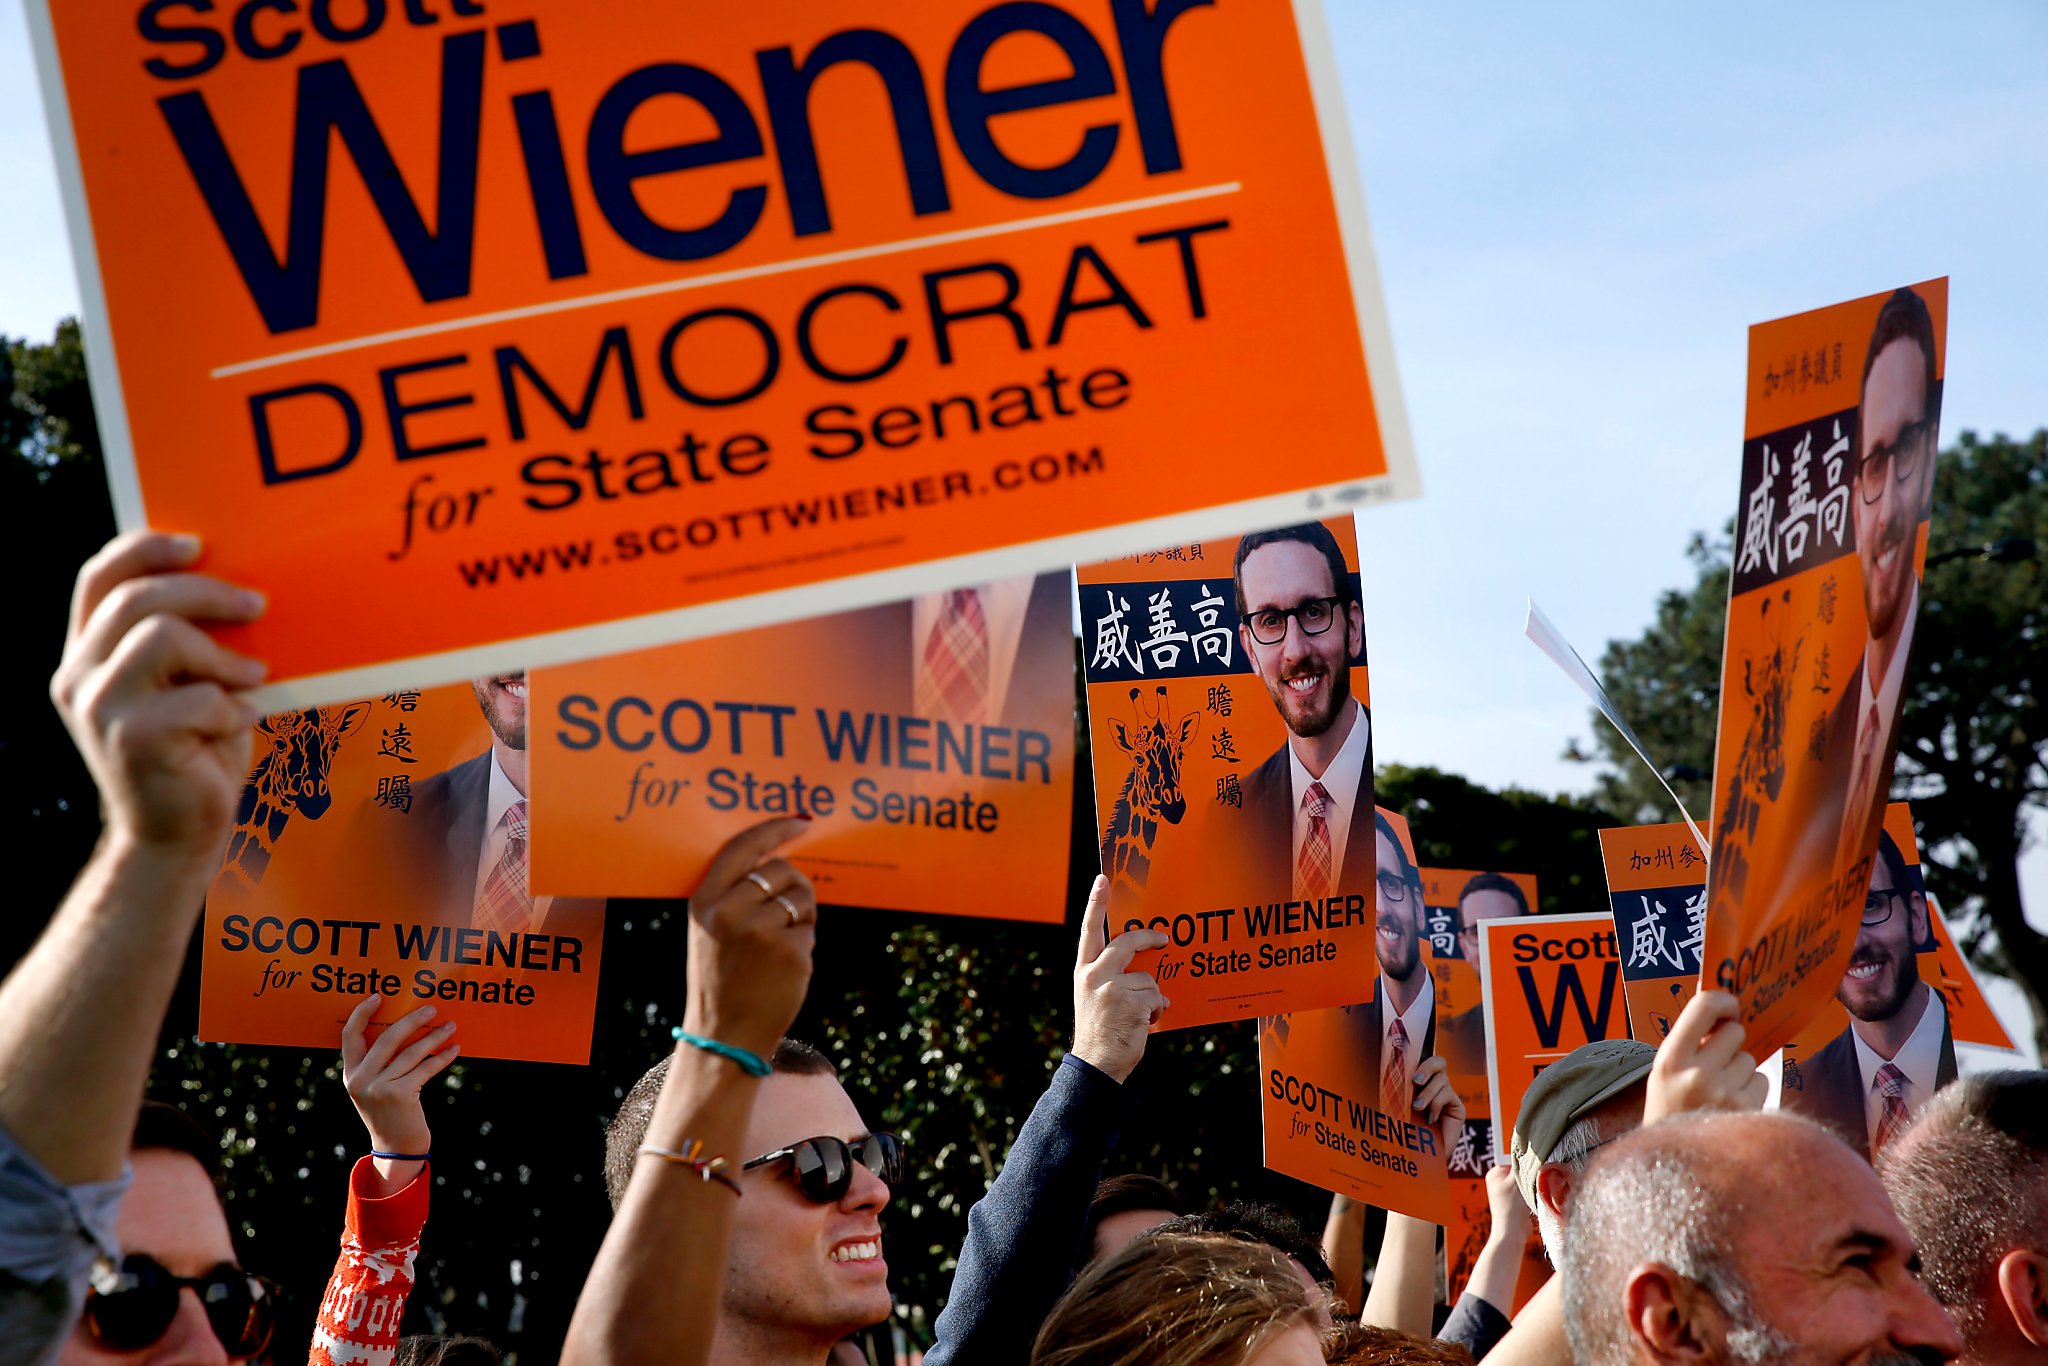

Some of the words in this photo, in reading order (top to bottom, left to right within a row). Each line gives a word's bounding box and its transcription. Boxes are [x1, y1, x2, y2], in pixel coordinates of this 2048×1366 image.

[137, 0, 486, 80] Sco
[156, 0, 1214, 335] Wiener
[248, 221, 1231, 486] DEMOCRAT
[387, 474, 494, 561] for
[521, 433, 770, 511] State
[805, 367, 1130, 460] Senate
[1736, 418, 1850, 575] 威善高
[1091, 584, 1233, 675] 威善高
[557, 694, 796, 758] SCOTT
[815, 708, 1052, 785] WIENER
[1206, 683, 1243, 809] 瞻遠矚
[614, 762, 691, 823] for
[706, 768, 835, 817] State
[850, 777, 999, 833] Senate
[220, 914, 381, 958] SCOTT
[393, 923, 583, 974] WIENER
[1243, 894, 1365, 939] WIENER
[1429, 907, 1456, 956] 高
[1512, 931, 1620, 963] Scott
[1717, 912, 1796, 995] SCOTT
[1794, 855, 1870, 948] WIENER
[253, 959, 303, 998] for
[310, 963, 401, 997] State
[412, 969, 536, 1006] Senate
[1155, 953, 1184, 984] for
[1189, 951, 1251, 978] State
[1258, 938, 1337, 970] Senate
[1516, 961, 1635, 1048] W
[1270, 1069, 1343, 1123] SCOTT
[1347, 1099, 1436, 1157] WIENER
[1289, 1111, 1312, 1140] for
[1314, 1121, 1357, 1157] State
[1360, 1139, 1418, 1178] Senate
